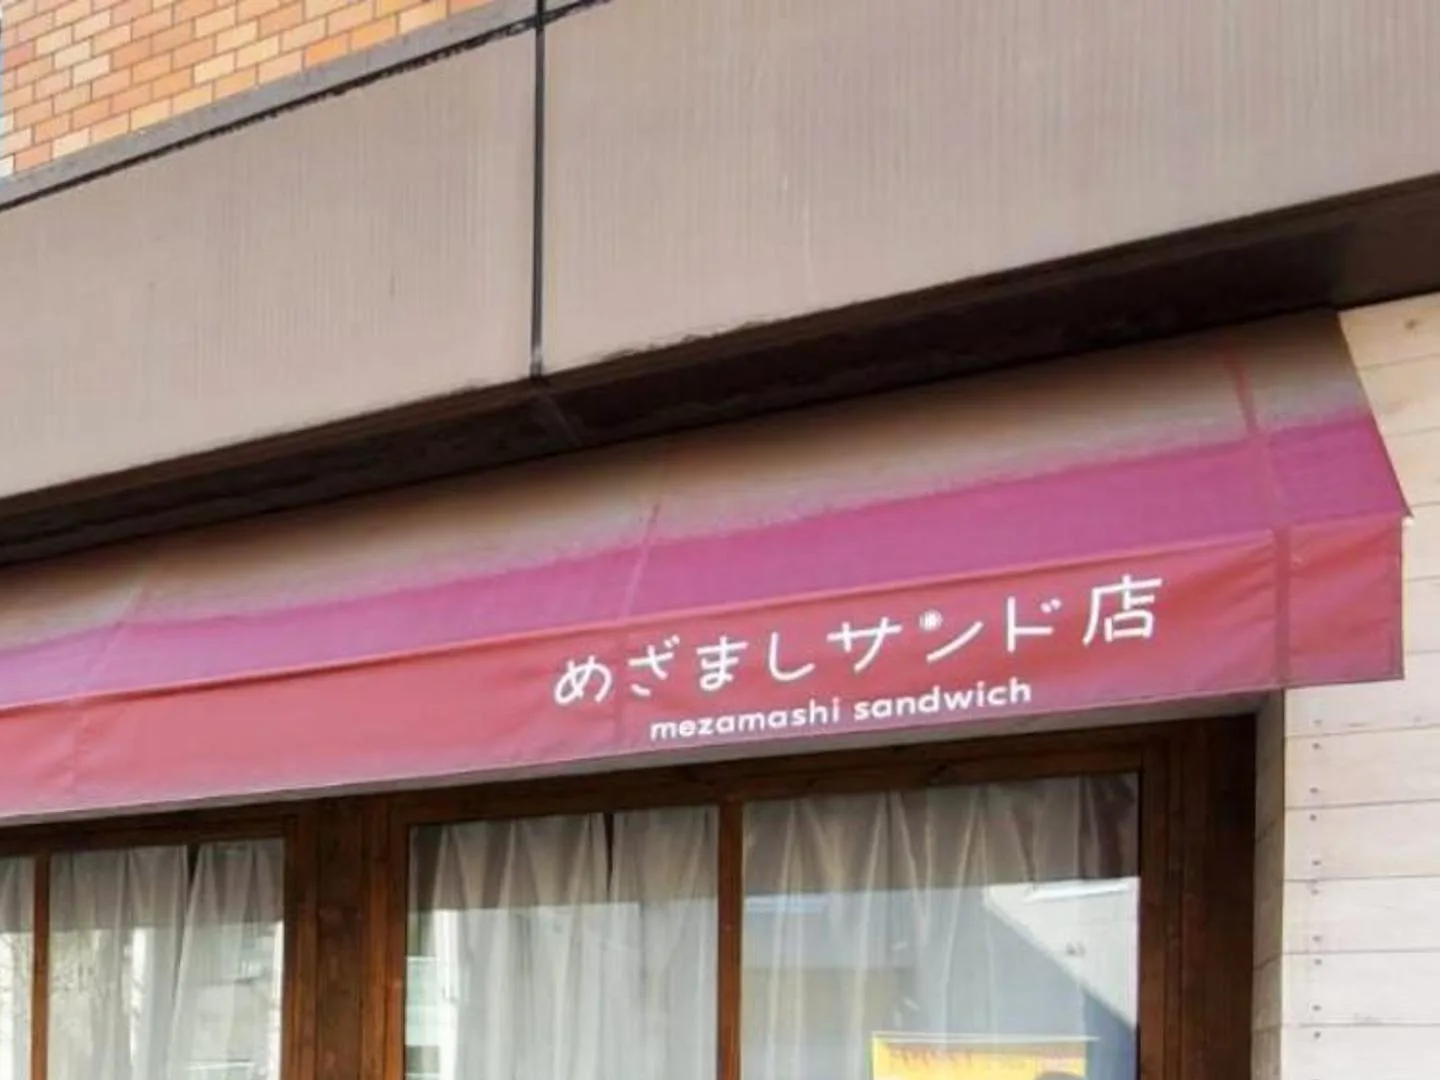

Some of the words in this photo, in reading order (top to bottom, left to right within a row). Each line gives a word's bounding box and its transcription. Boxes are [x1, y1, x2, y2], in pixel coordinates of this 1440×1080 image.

[554, 574, 1164, 705] めざましサンド店
[651, 698, 841, 740] mezamashi
[854, 676, 1033, 721] sandwich
